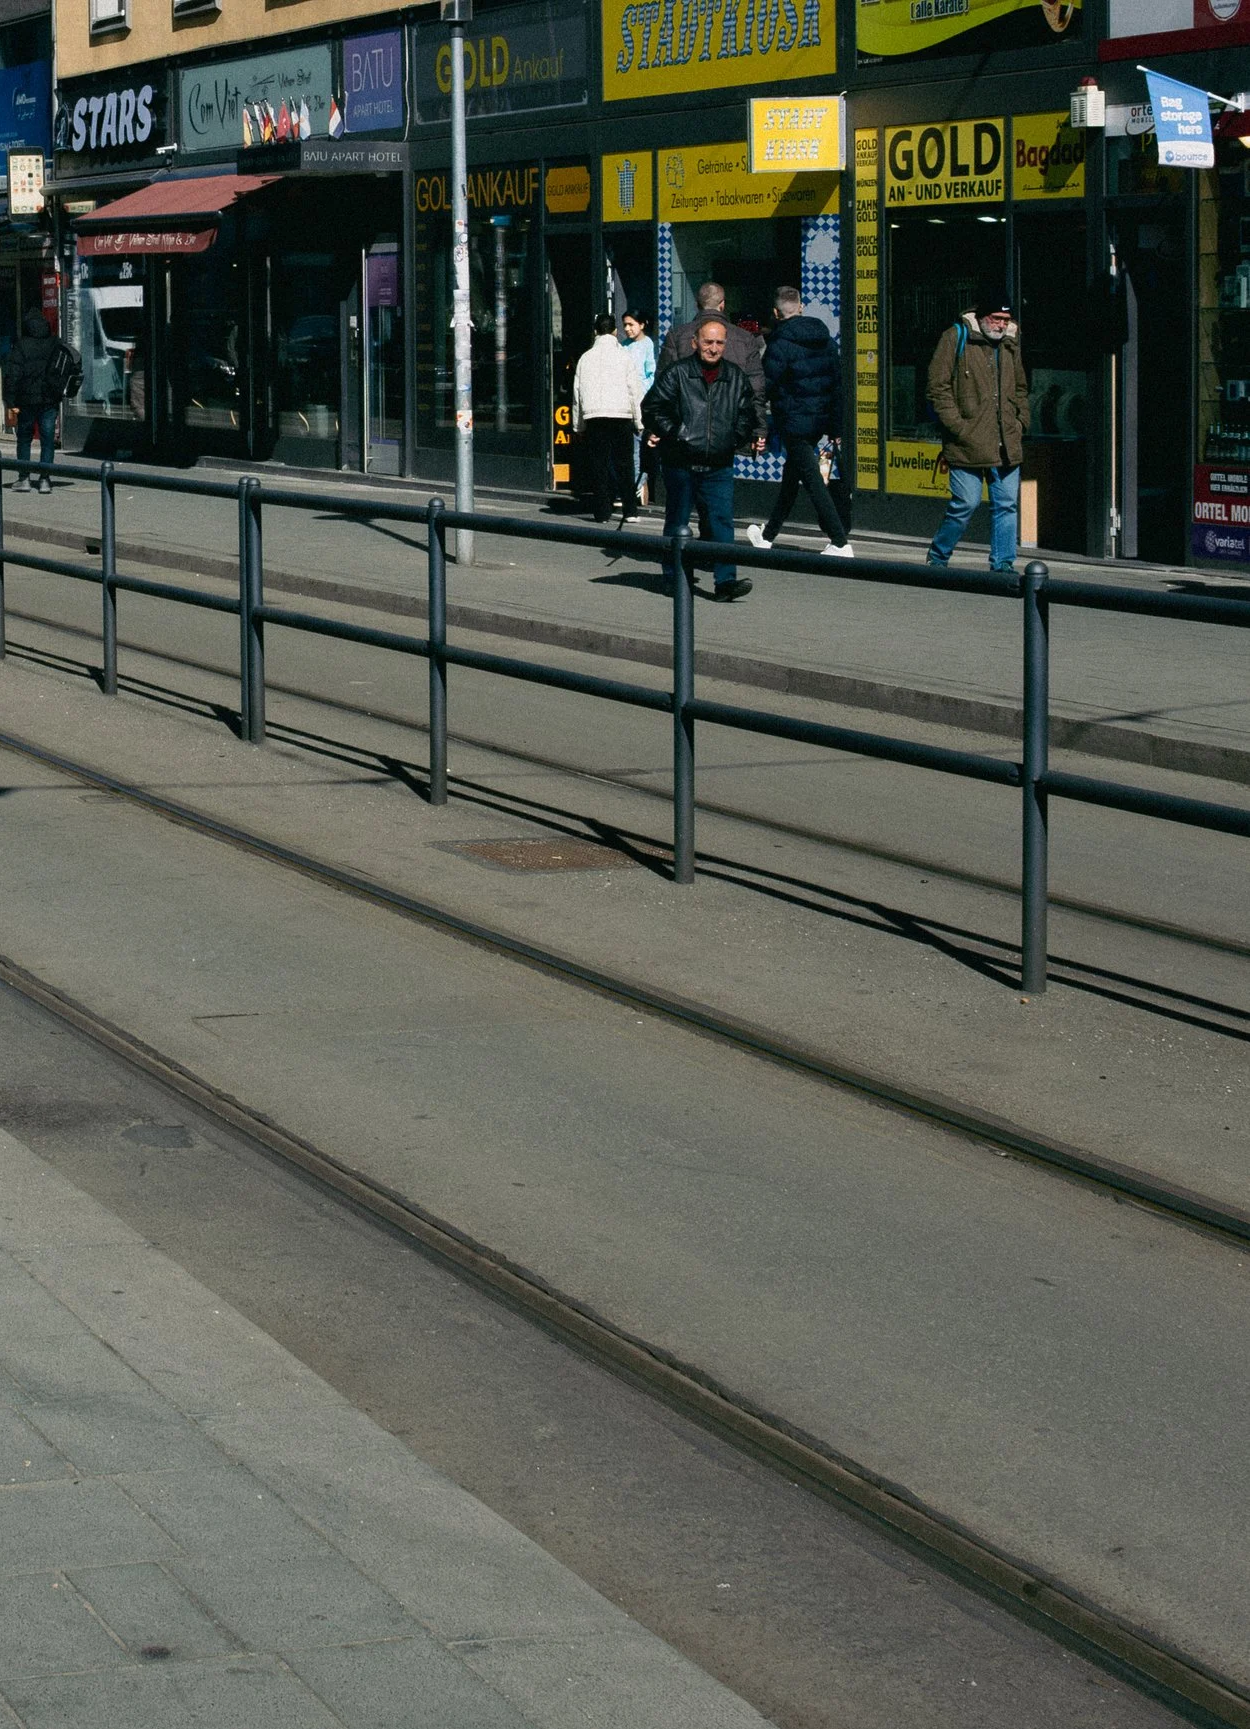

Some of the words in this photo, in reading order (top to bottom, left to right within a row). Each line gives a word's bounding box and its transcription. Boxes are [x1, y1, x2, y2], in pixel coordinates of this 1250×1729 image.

[352, 47, 393, 92] BATU
[435, 36, 510, 94] GOLD
[513, 48, 564, 83] Ankauf
[353, 102, 372, 117] APART
[373, 100, 394, 114] HOTEL
[1131, 104, 1153, 117] orte
[1160, 96, 1184, 110] Bag
[72, 84, 154, 151] STARS
[764, 107, 828, 130] STADT
[1160, 111, 1203, 123] storage
[1177, 123, 1203, 135] here
[764, 138, 822, 160] KIOSK
[856, 139, 878, 150] GOLD
[888, 122, 1002, 181] GOLD
[331, 152, 365, 162] APART
[368, 152, 402, 163] HOTEL
[1016, 131, 1085, 176] Bagdad
[1174, 151, 1208, 162] bounce
[697, 155, 733, 175] Getränke
[416, 176, 451, 211] GOL
[467, 168, 539, 208] ANKAUF
[888, 185, 906, 202] AN
[915, 181, 942, 200] UND
[945, 178, 1002, 199] VERKAUF
[671, 193, 708, 212] Zeitungen
[715, 189, 764, 206] Tabakwaren
[856, 200, 878, 211] ZAHN
[856, 211, 878, 222] GOLD
[856, 236, 878, 245] BRUCH
[856, 245, 878, 257] GOLD
[856, 269, 878, 279] SILBER
[857, 305, 878, 321] BAR
[857, 322, 878, 333] GELD
[888, 451, 936, 471] Juwelier
[1195, 501, 1228, 521] ORTEL
[1231, 504, 1250, 523] MO
[1215, 536, 1245, 550] variatel
